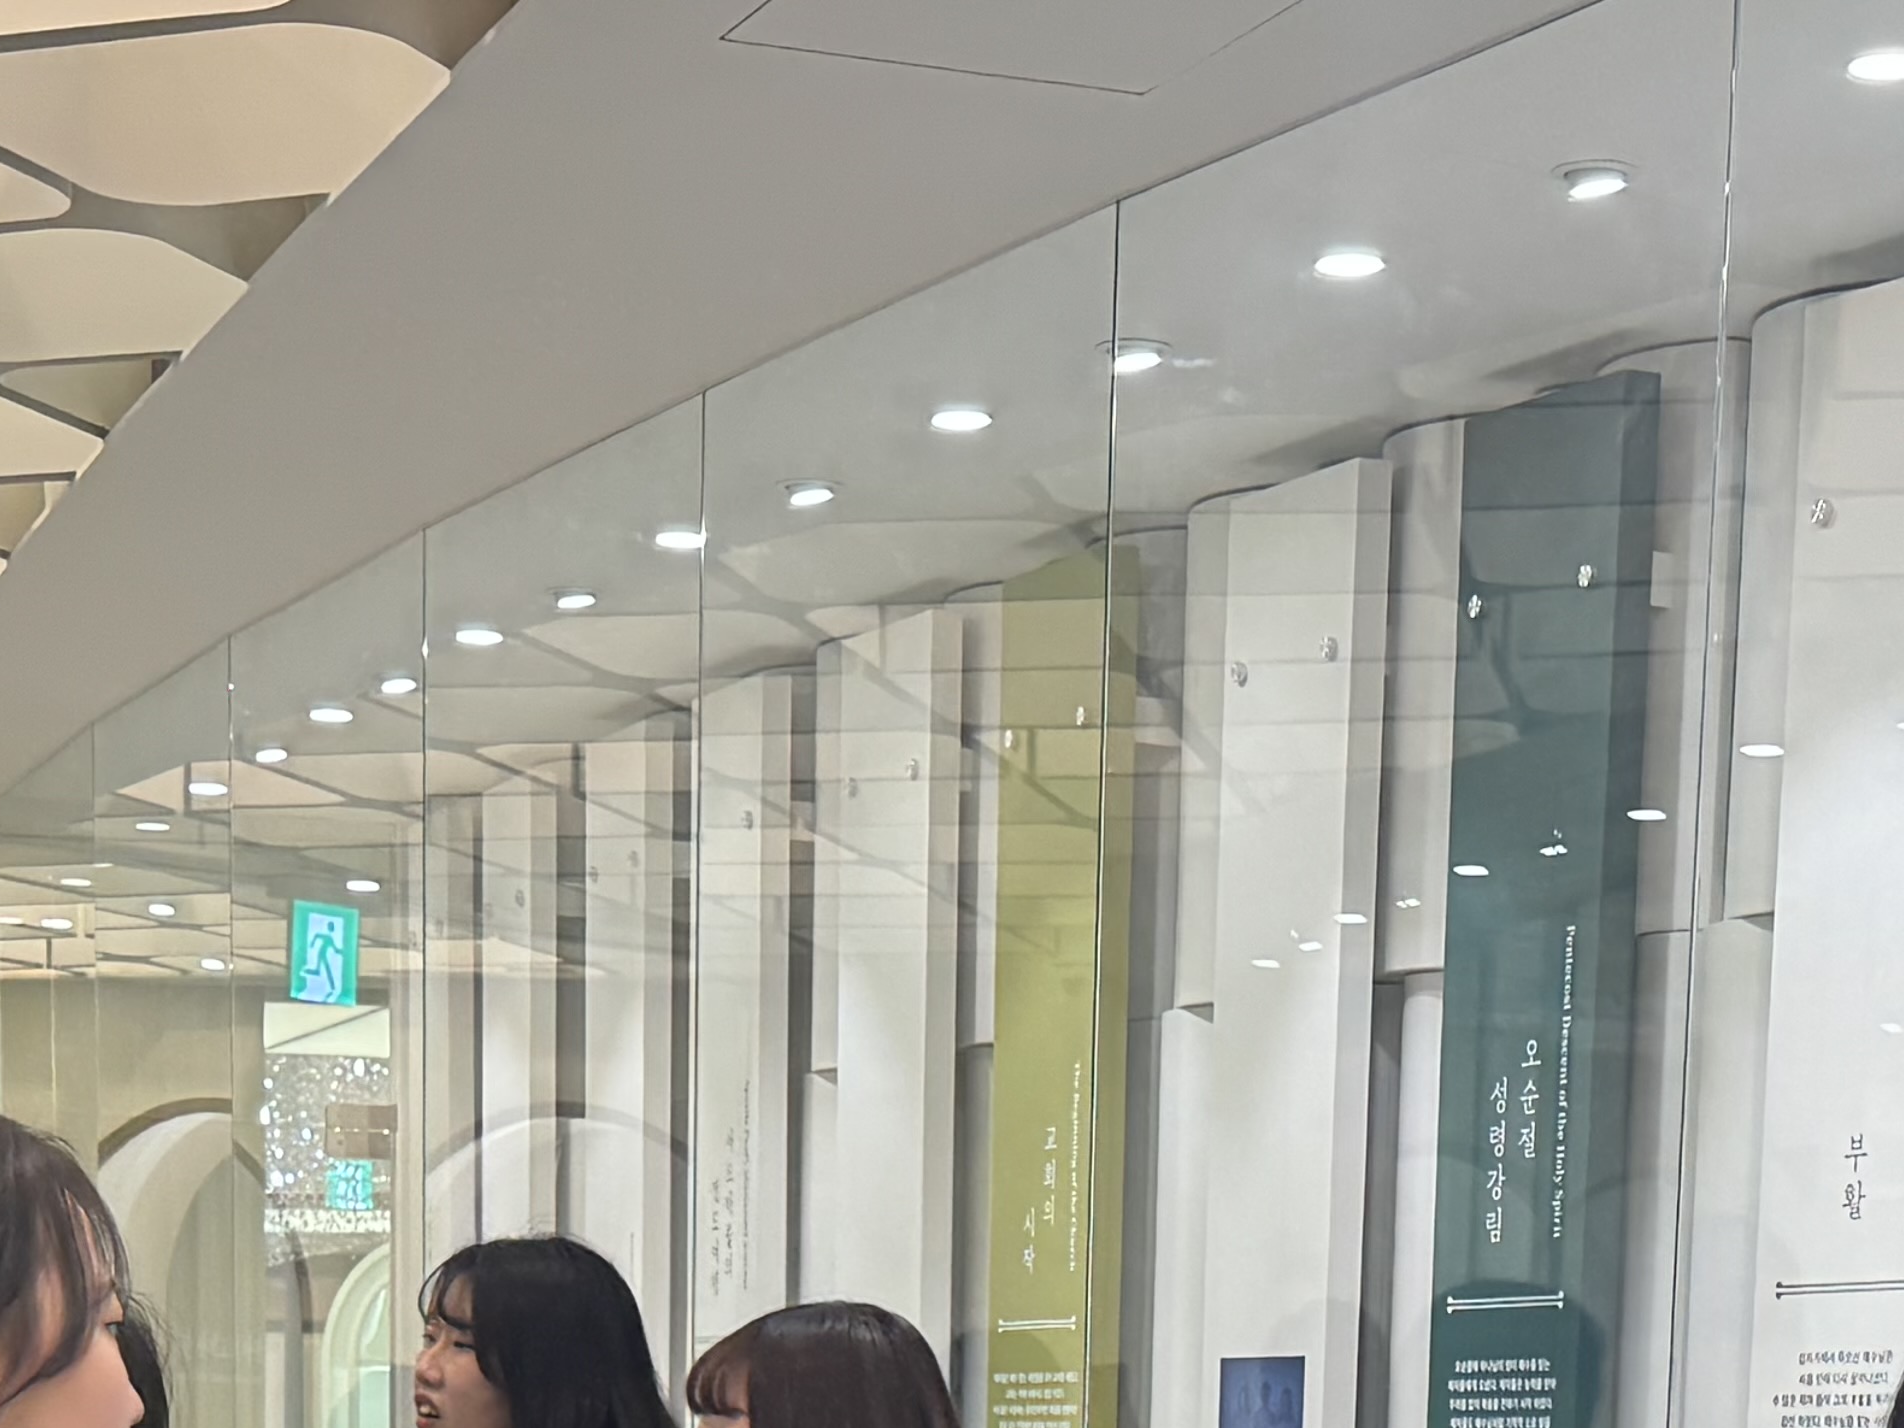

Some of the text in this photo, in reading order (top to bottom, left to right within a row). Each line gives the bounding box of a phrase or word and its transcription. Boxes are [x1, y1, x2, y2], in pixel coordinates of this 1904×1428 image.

[1518, 1039, 1542, 1159] 오순절
[1552, 924, 1576, 1239] Pentecost Descent of the Holy Spirit
[1484, 1076, 1509, 1244] 성령강림
[1841, 1132, 1868, 1221] 부활
